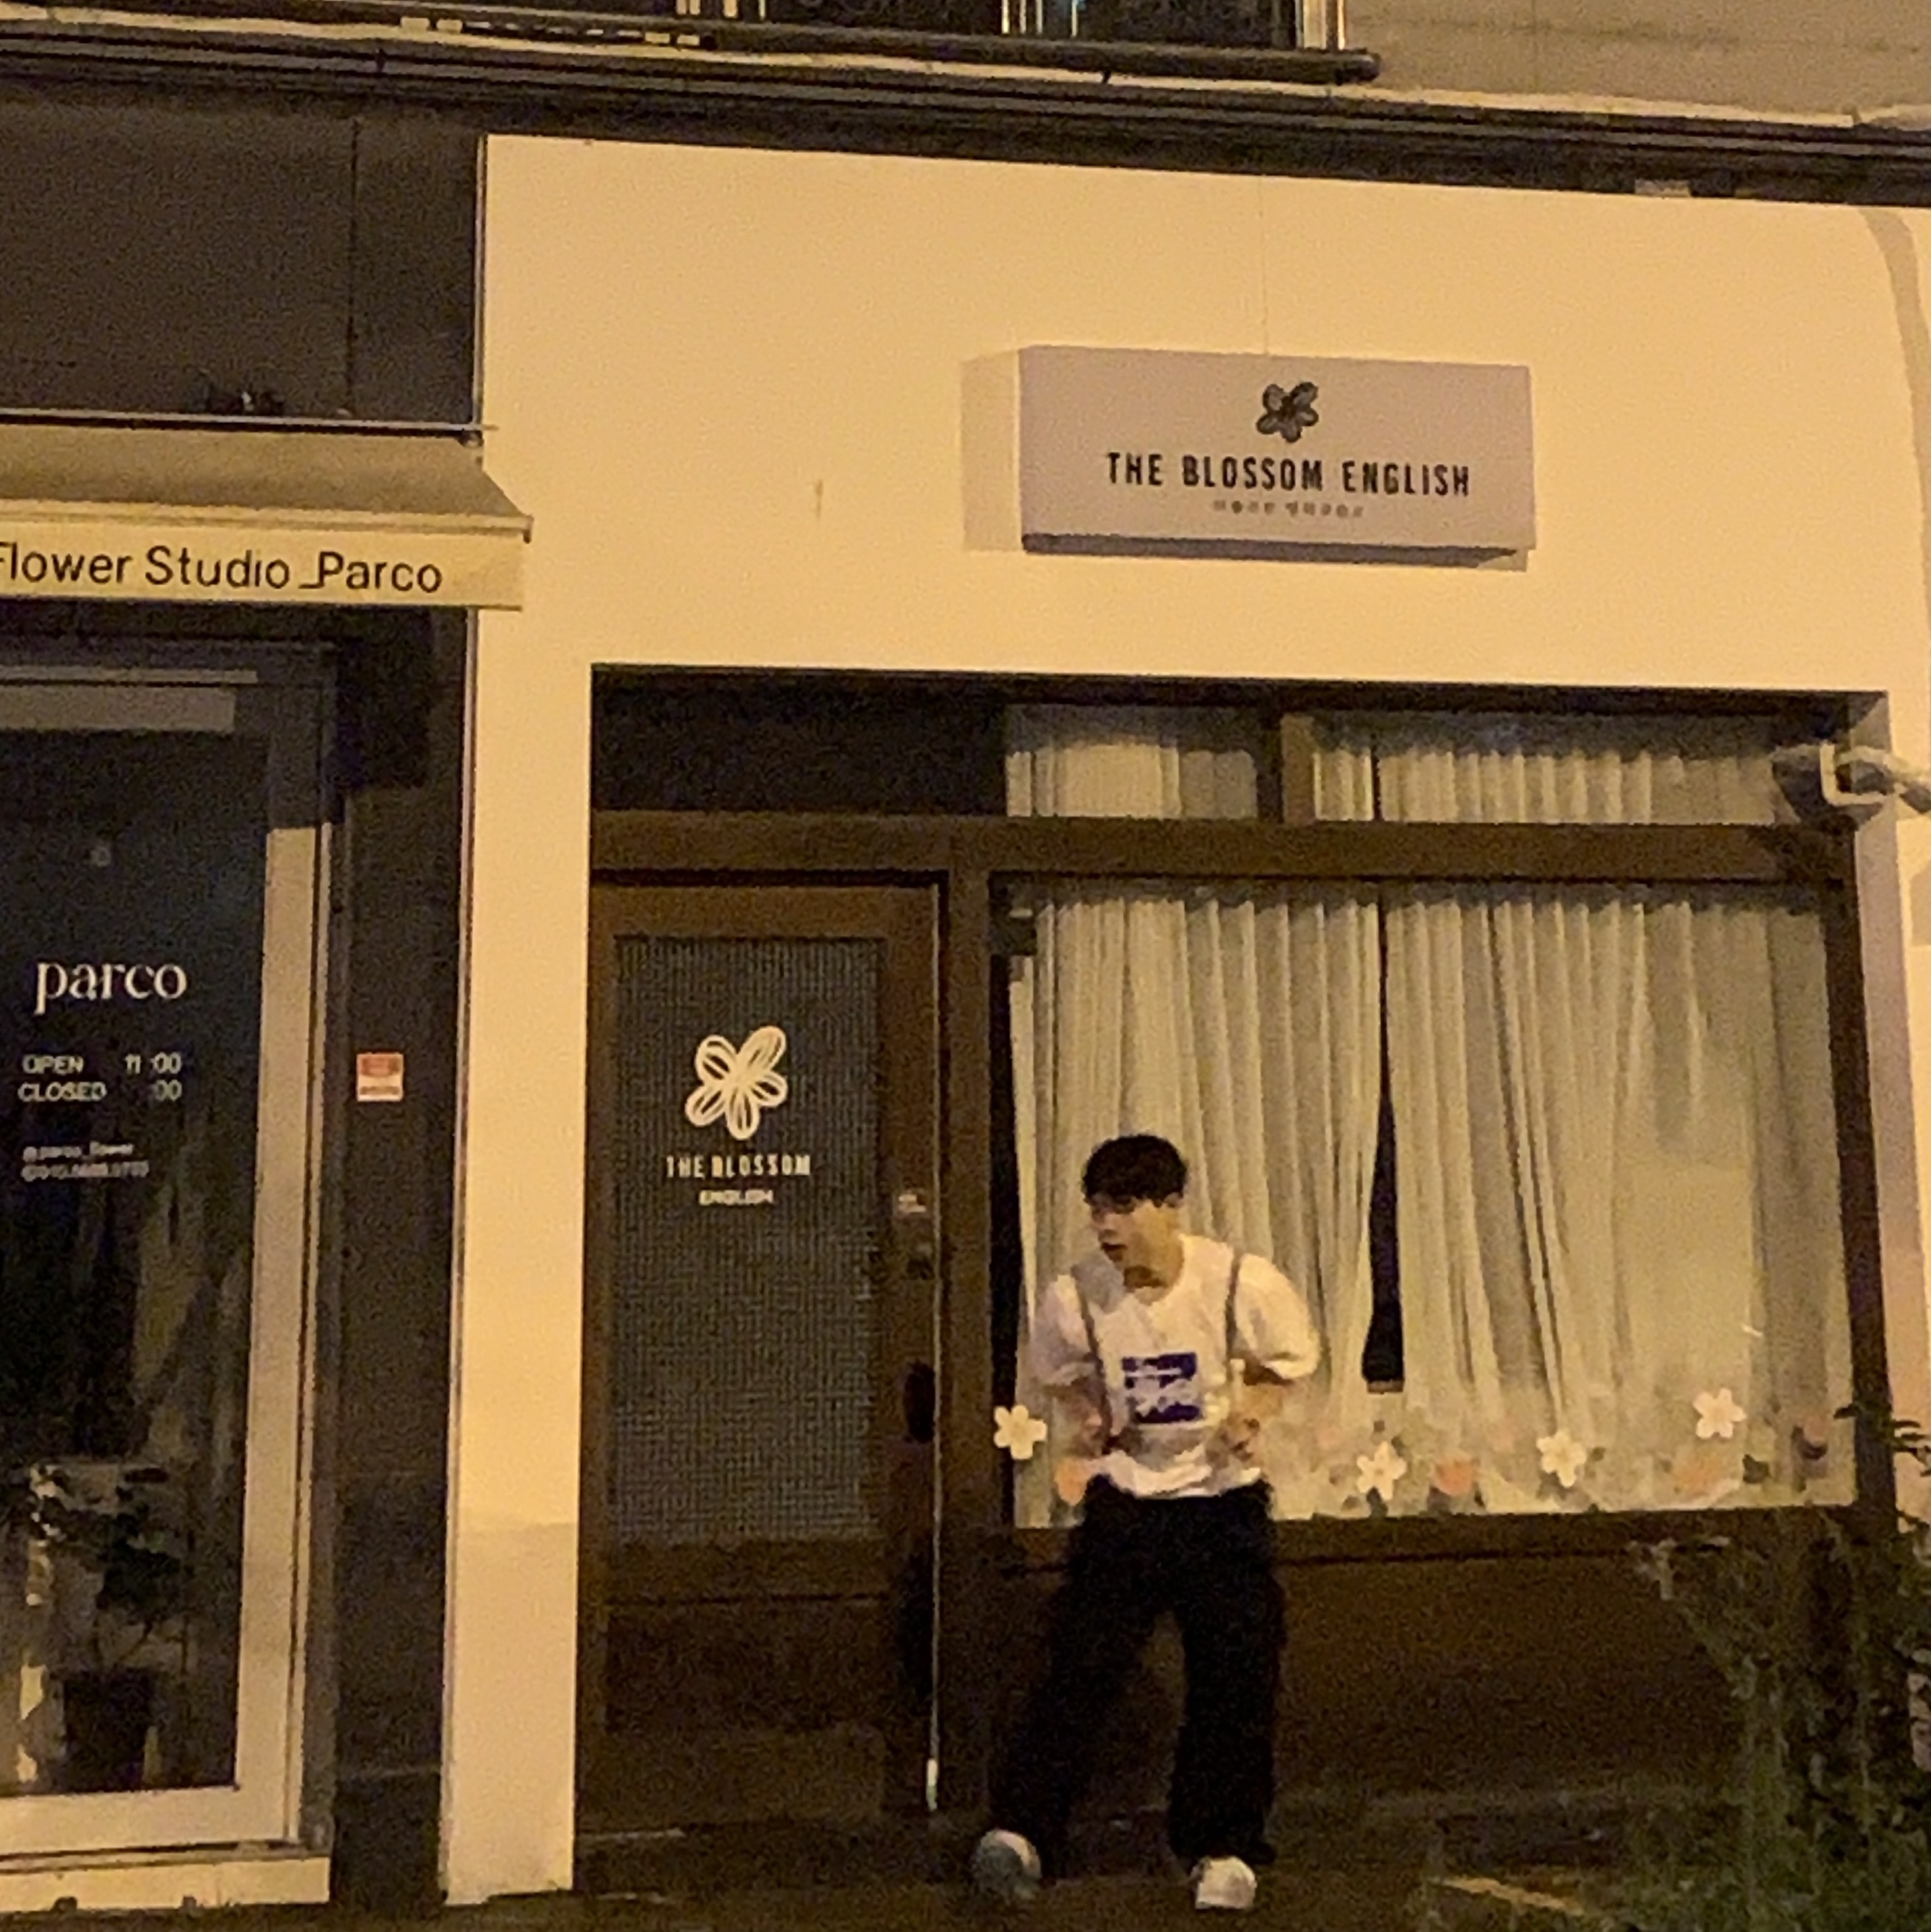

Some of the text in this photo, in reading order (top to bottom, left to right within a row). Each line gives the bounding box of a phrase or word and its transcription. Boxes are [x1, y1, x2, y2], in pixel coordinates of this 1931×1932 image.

[1107, 452, 1470, 496] THE BLOSSOM ENGLISH
[145, 545, 290, 589] Studio
[34, 963, 188, 1015] parco
[22, 1054, 85, 1075] OPEN
[18, 1082, 107, 1102] CLOSED
[666, 1154, 811, 1179] THE BLOSSOM
